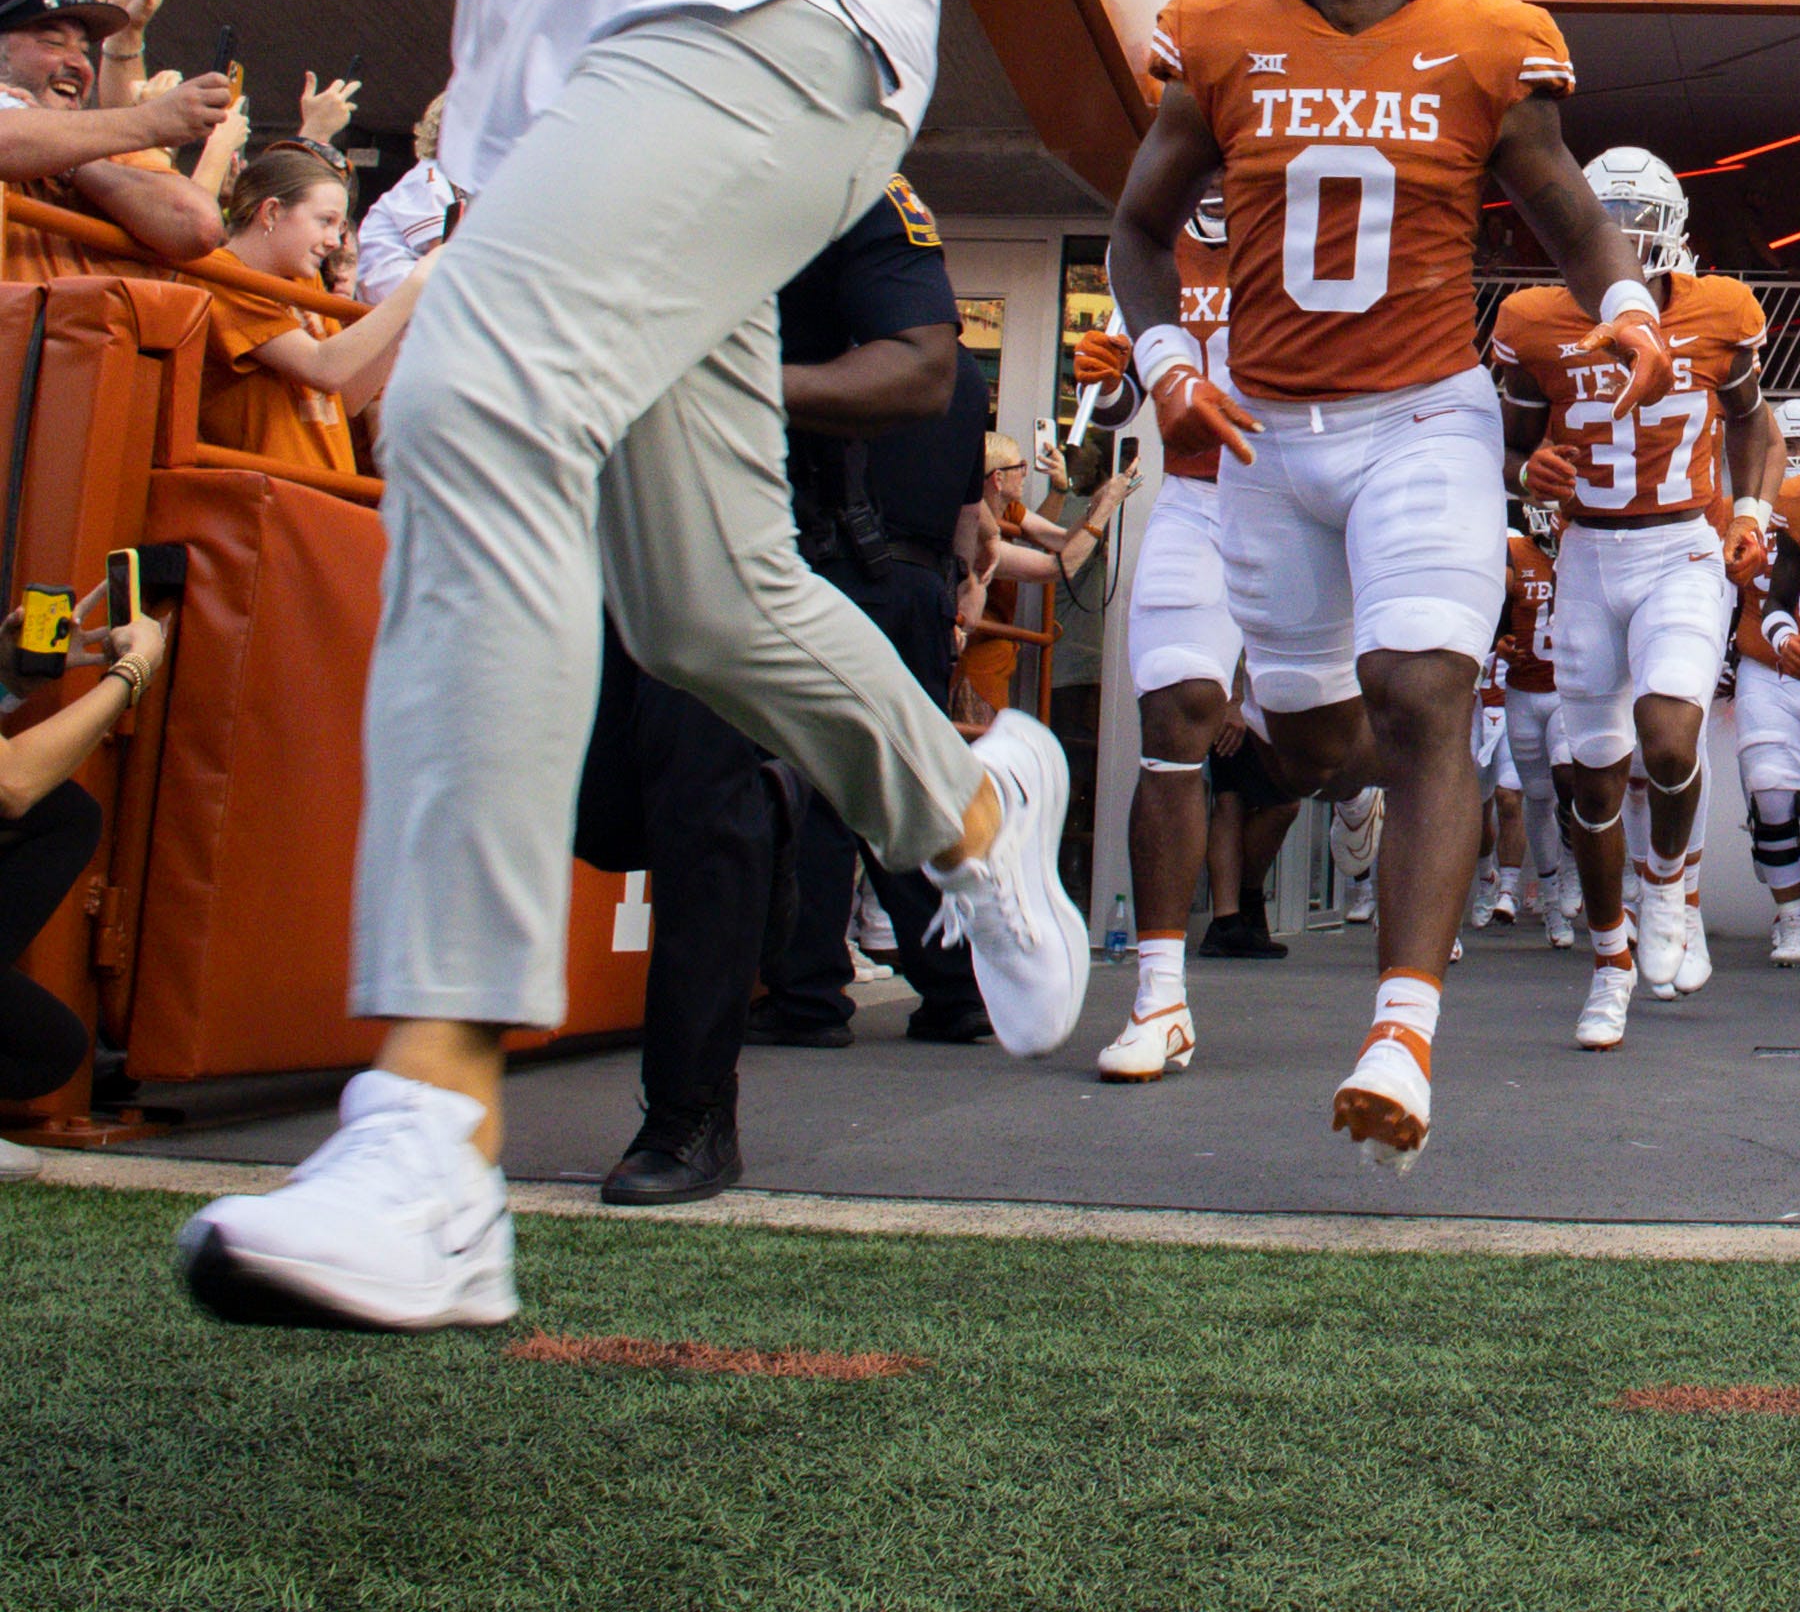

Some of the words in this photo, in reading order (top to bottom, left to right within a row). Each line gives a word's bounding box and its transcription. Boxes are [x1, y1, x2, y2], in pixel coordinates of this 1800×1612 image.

[1252, 88, 1441, 142] TEXAS
[1283, 144, 1396, 313] 0
[1566, 358, 1692, 400] TES
[1565, 389, 1708, 509] 37
